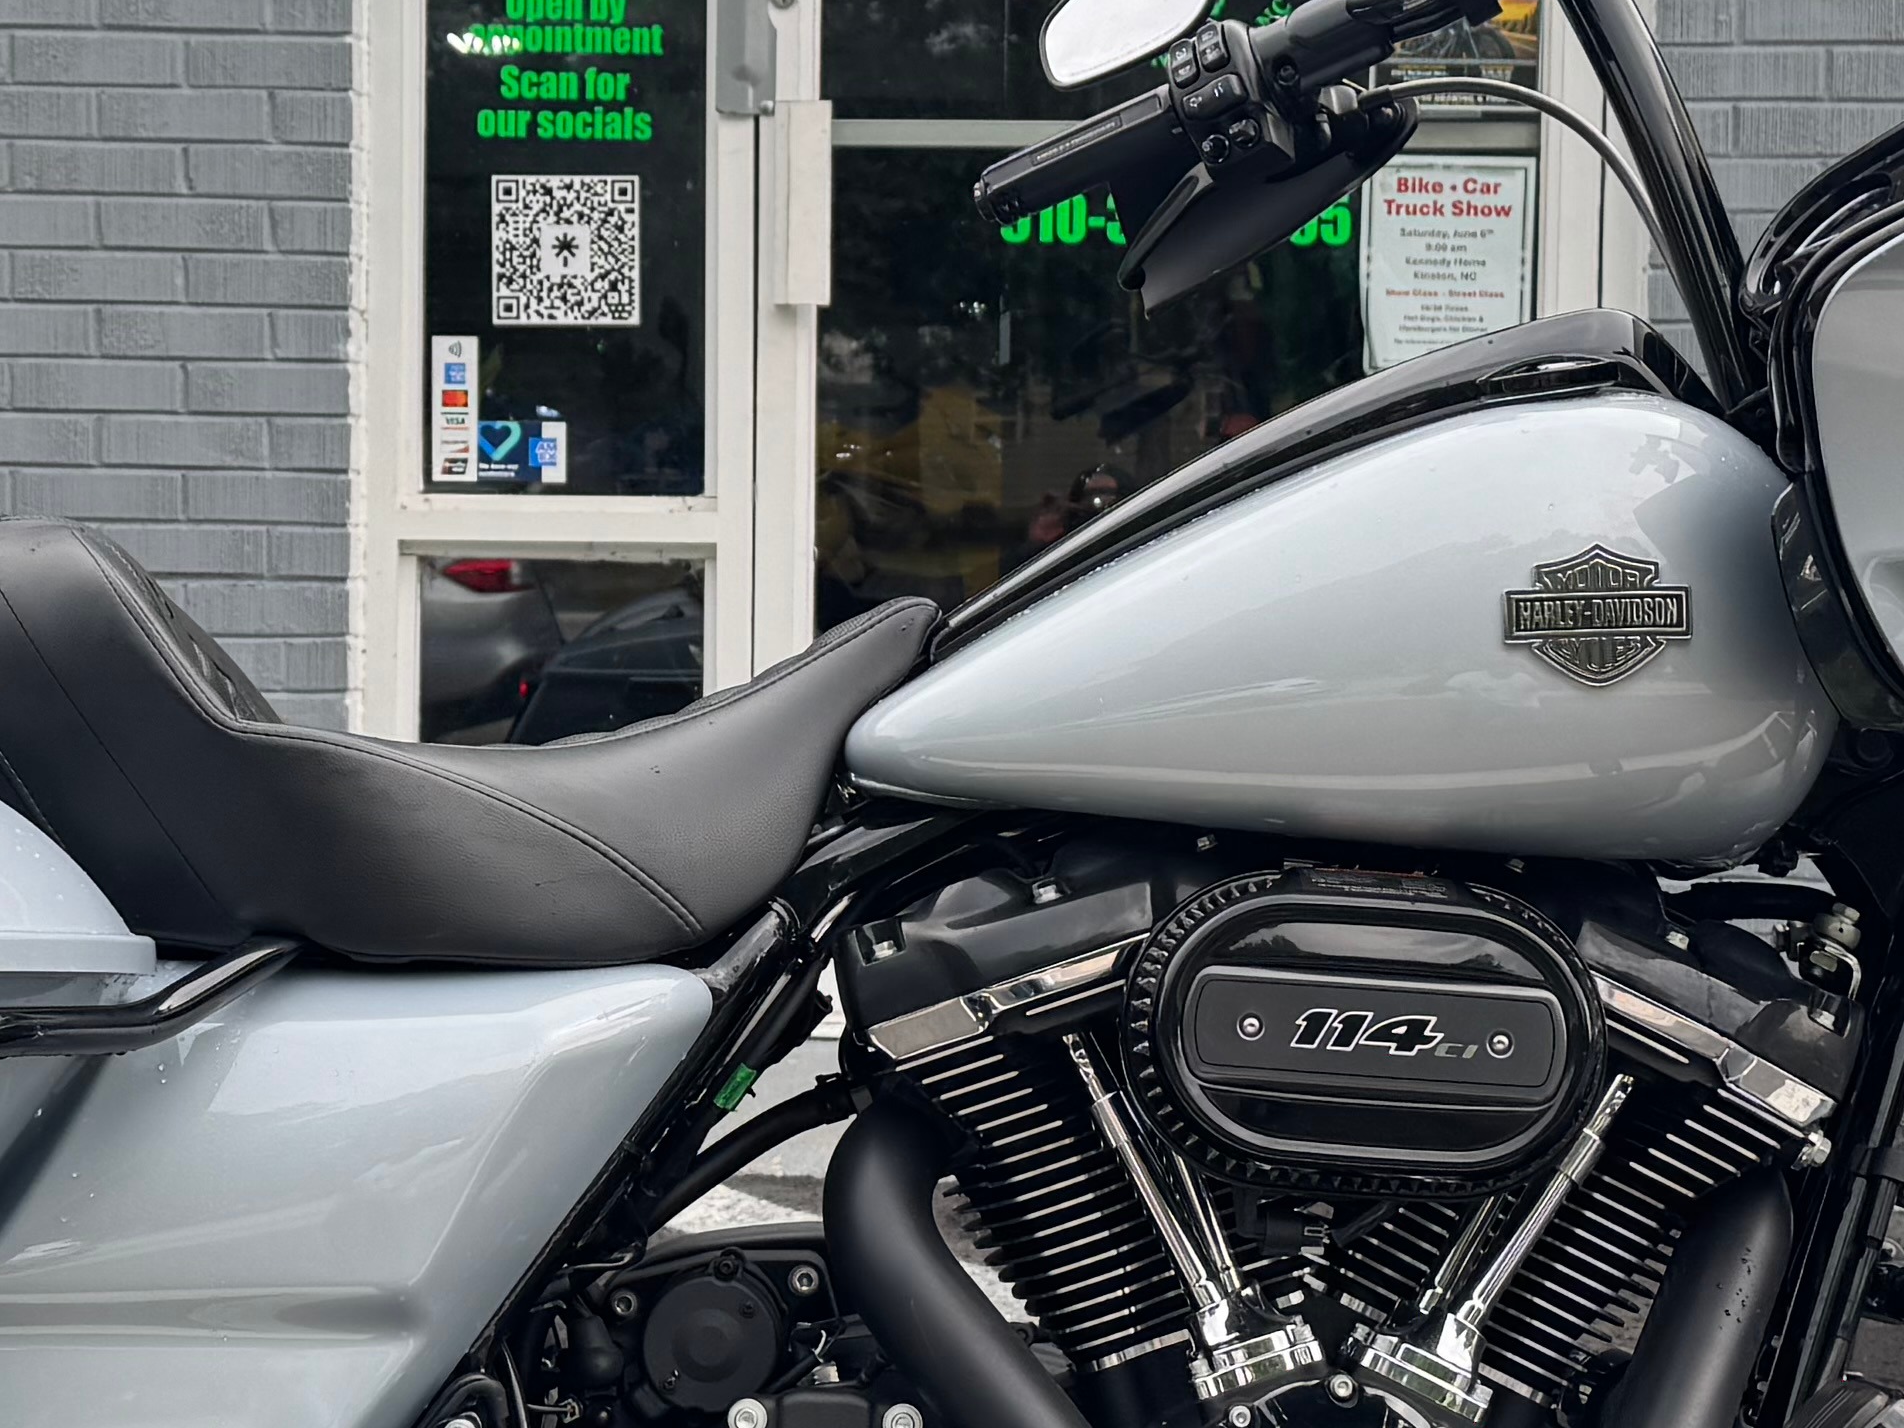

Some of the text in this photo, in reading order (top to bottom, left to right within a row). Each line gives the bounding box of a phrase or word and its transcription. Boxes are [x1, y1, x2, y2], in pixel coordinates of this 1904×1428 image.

[500, 65, 631, 102] Scan for
[477, 107, 652, 141] our socials
[1397, 177, 1503, 195] Bike Car
[1383, 199, 1513, 217] Truck Show
[1518, 597, 1677, 630] HARLEY-DAVIDSON
[1289, 1008, 1478, 1059] 114 CI
